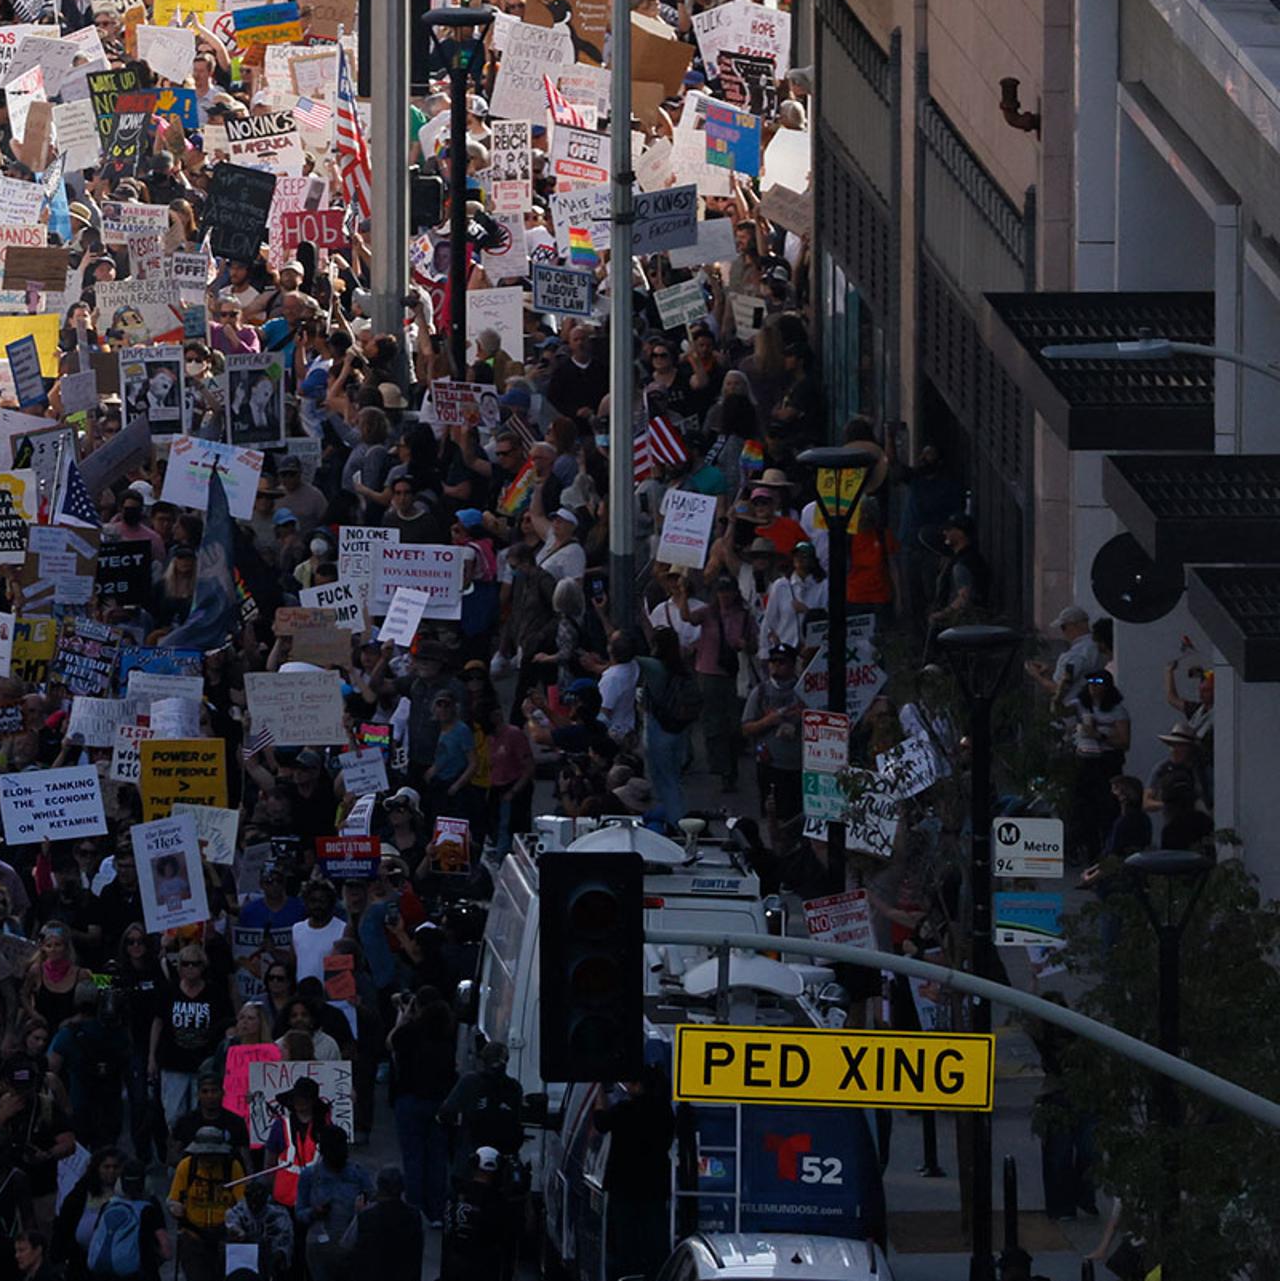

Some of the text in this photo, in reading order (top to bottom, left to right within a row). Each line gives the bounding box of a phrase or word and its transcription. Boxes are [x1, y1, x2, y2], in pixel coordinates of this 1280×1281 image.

[228, 113, 297, 140] NO KINGS
[245, 137, 293, 152] AMERICA
[538, 270, 588, 284] NO ONE IS
[545, 283, 580, 297] ABOVE
[541, 296, 585, 312] THE LAW
[316, 583, 354, 607] FUCK
[44, 776, 94, 791] TANKING
[13, 794, 95, 809] THE ECONOMY
[31, 809, 67, 821] WHILE
[18, 816, 99, 834] ON KETAMINE
[1023, 839, 1060, 853] Metro
[996, 858, 1015, 873] 94
[172, 1000, 210, 1017] HANDS
[172, 1013, 211, 1030] OFF!
[704, 1041, 967, 1094] PED XING
[800, 1155, 845, 1186] 52
[739, 1201, 844, 1217] TELEMUNDO52.com
